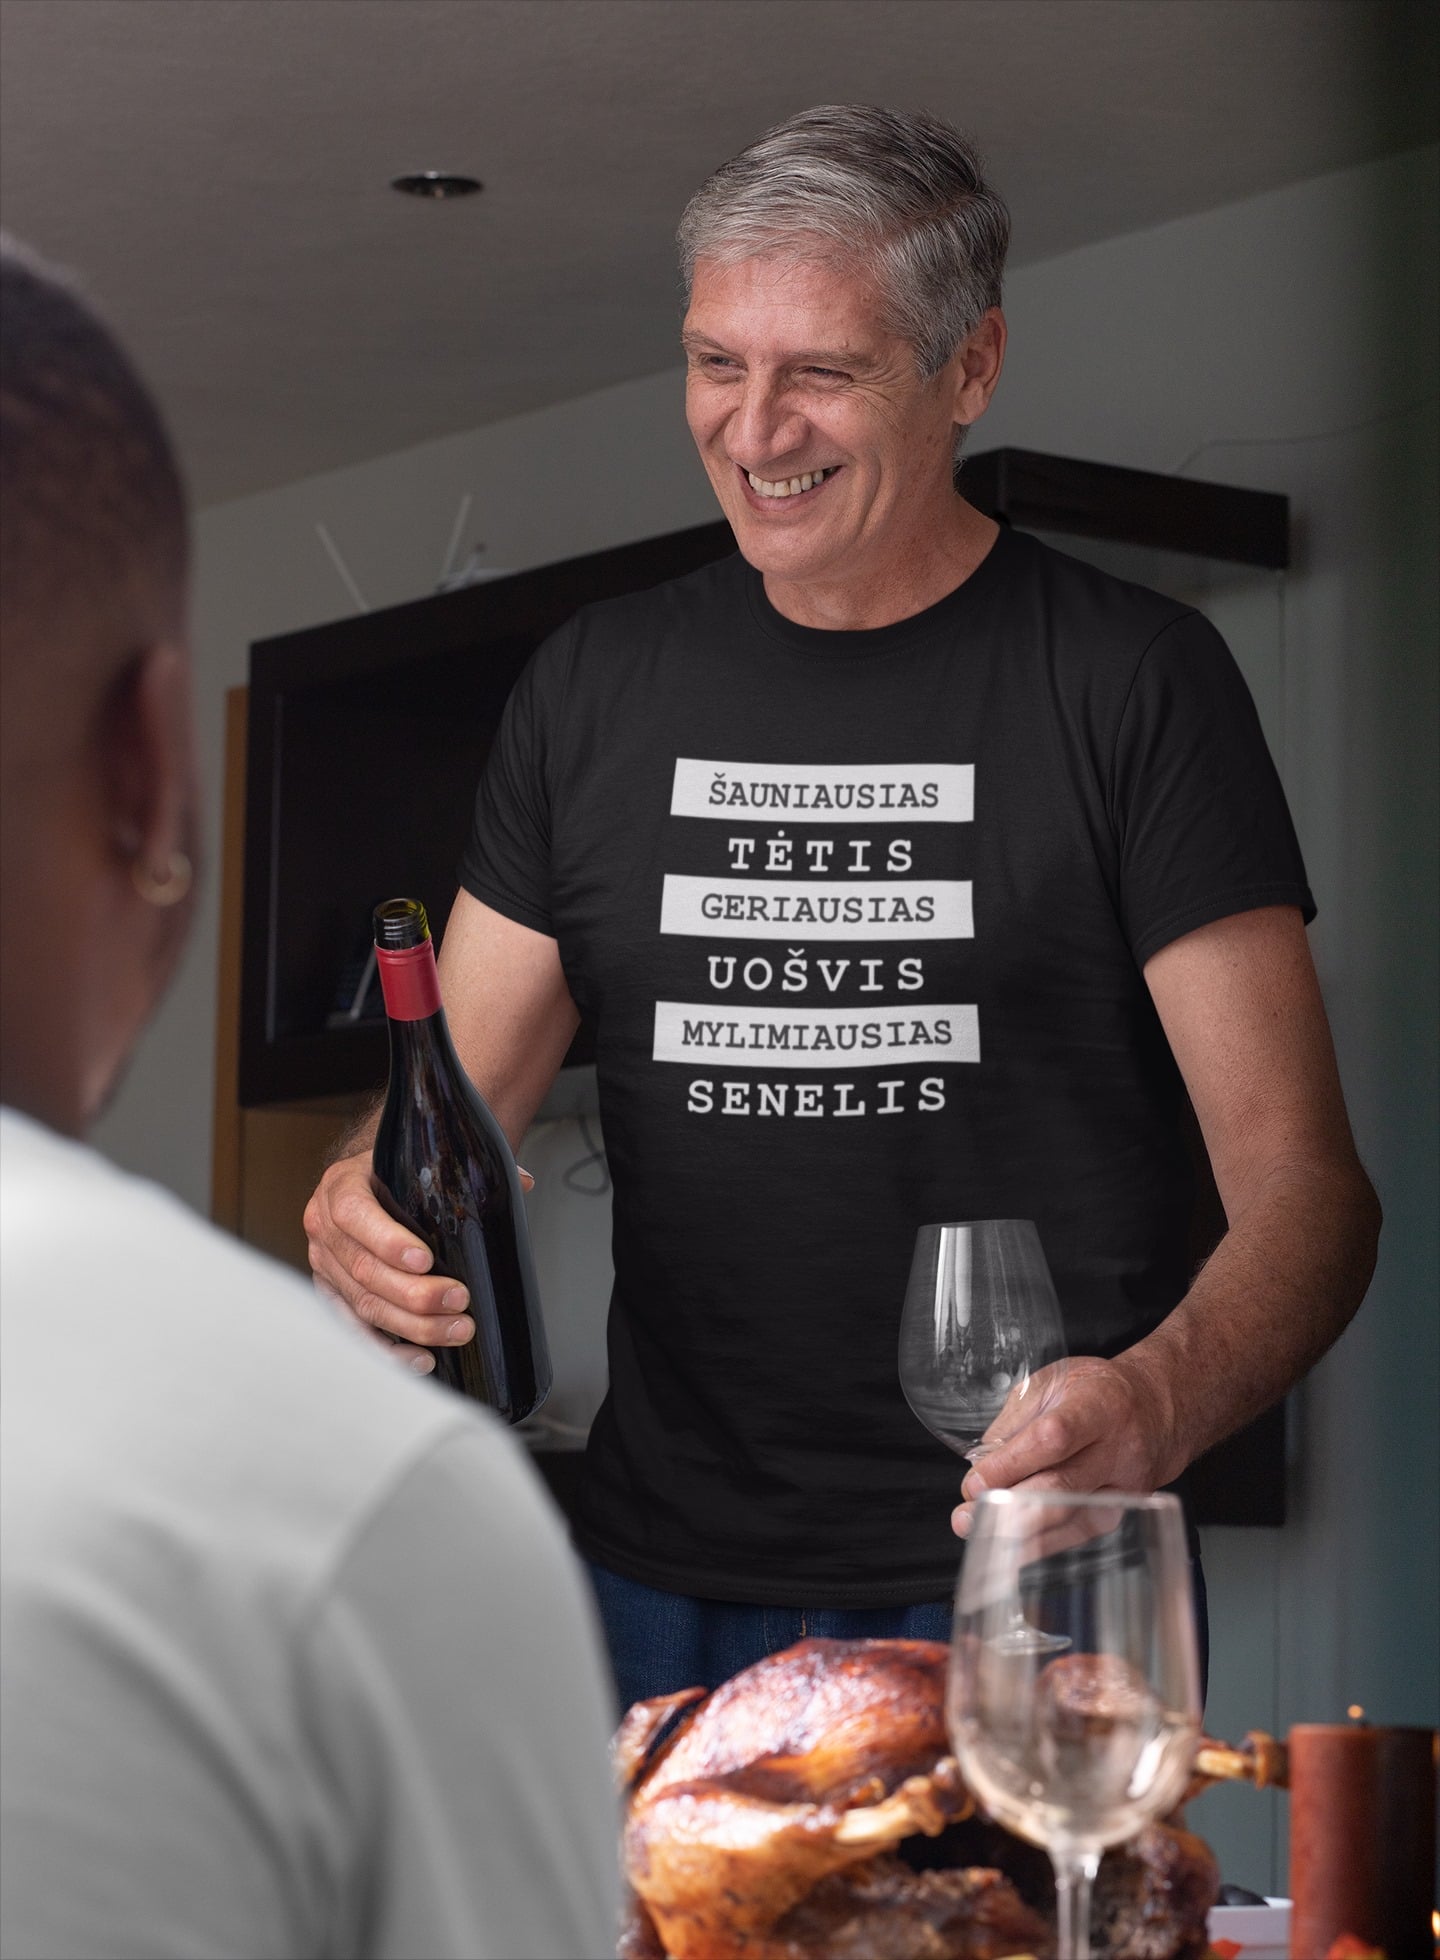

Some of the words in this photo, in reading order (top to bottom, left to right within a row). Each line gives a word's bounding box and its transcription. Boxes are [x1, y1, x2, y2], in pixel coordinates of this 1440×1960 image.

[708, 772, 940, 809] ŠAUNIAUSIAS
[728, 830, 913, 872] TĖTIS
[700, 892, 936, 923] GERIAUSIAS
[707, 947, 925, 992] UOŠVIS
[681, 1019, 953, 1050] MYLIMIAUSIAS
[687, 1077, 946, 1117] SENELIS
